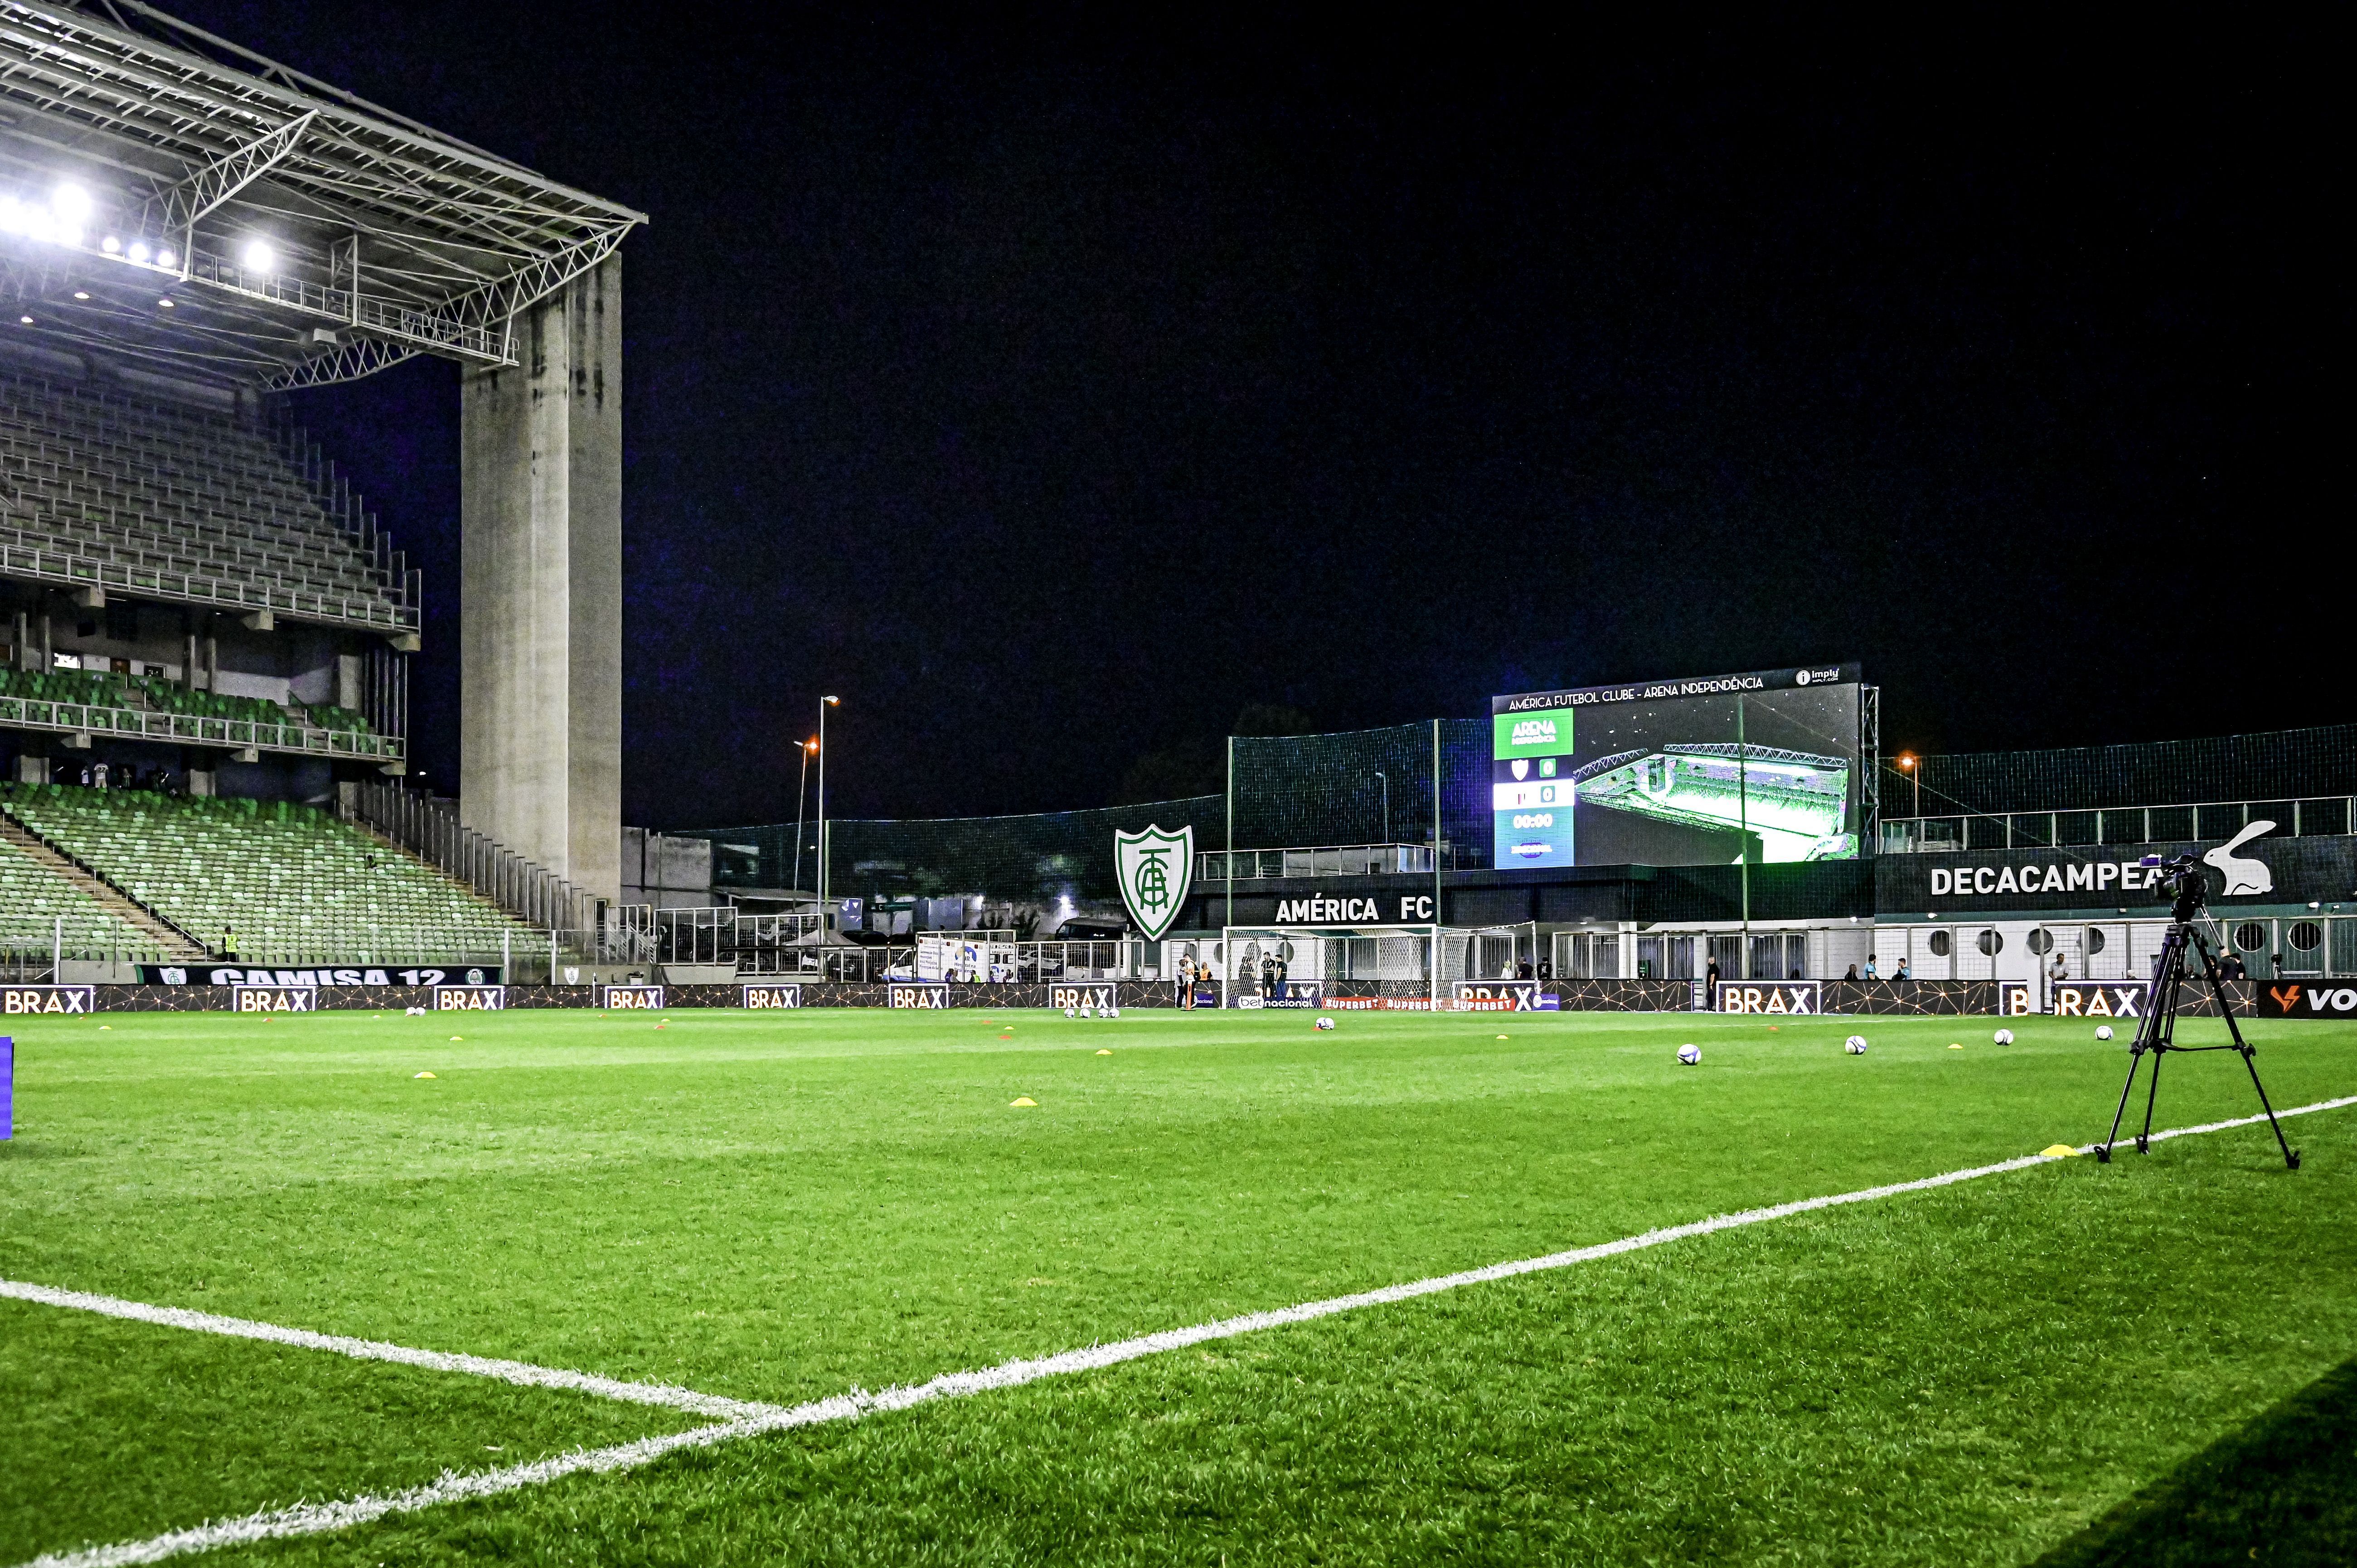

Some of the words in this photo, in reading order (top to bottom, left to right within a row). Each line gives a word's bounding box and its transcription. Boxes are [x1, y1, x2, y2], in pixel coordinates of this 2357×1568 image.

[1509, 696, 1552, 711] AMÉRICA
[1555, 692, 1599, 706] FUTEBOL
[1602, 688, 1635, 702] CLUBE
[1644, 685, 1678, 698] ARENA
[1681, 676, 1763, 695] INDEPENDÊNCIA
[1512, 720, 1556, 737] ARENA
[1543, 761, 1553, 775] 0
[1542, 788, 1553, 801] 0
[1513, 813, 1553, 829] 00:00
[1275, 893, 1379, 922] AMÉRICA
[1401, 896, 1433, 920] FC
[210, 968, 391, 985] CAMISA
[398, 969, 446, 985] 12
[5, 991, 85, 1013] BRAX
[241, 991, 308, 1011] BRAX
[440, 990, 498, 1010] BRAX
[611, 991, 657, 1008] BRAX
[749, 989, 794, 1008] BRAX
[894, 988, 943, 1008] BRAX
[1054, 989, 1109, 1008] BRAX
[1326, 998, 1378, 1009] SUPERBET
[1387, 999, 1443, 1010] SUPERBT
[1453, 999, 1511, 1011] SUPERBET
[1726, 988, 1810, 1014] BRAX
